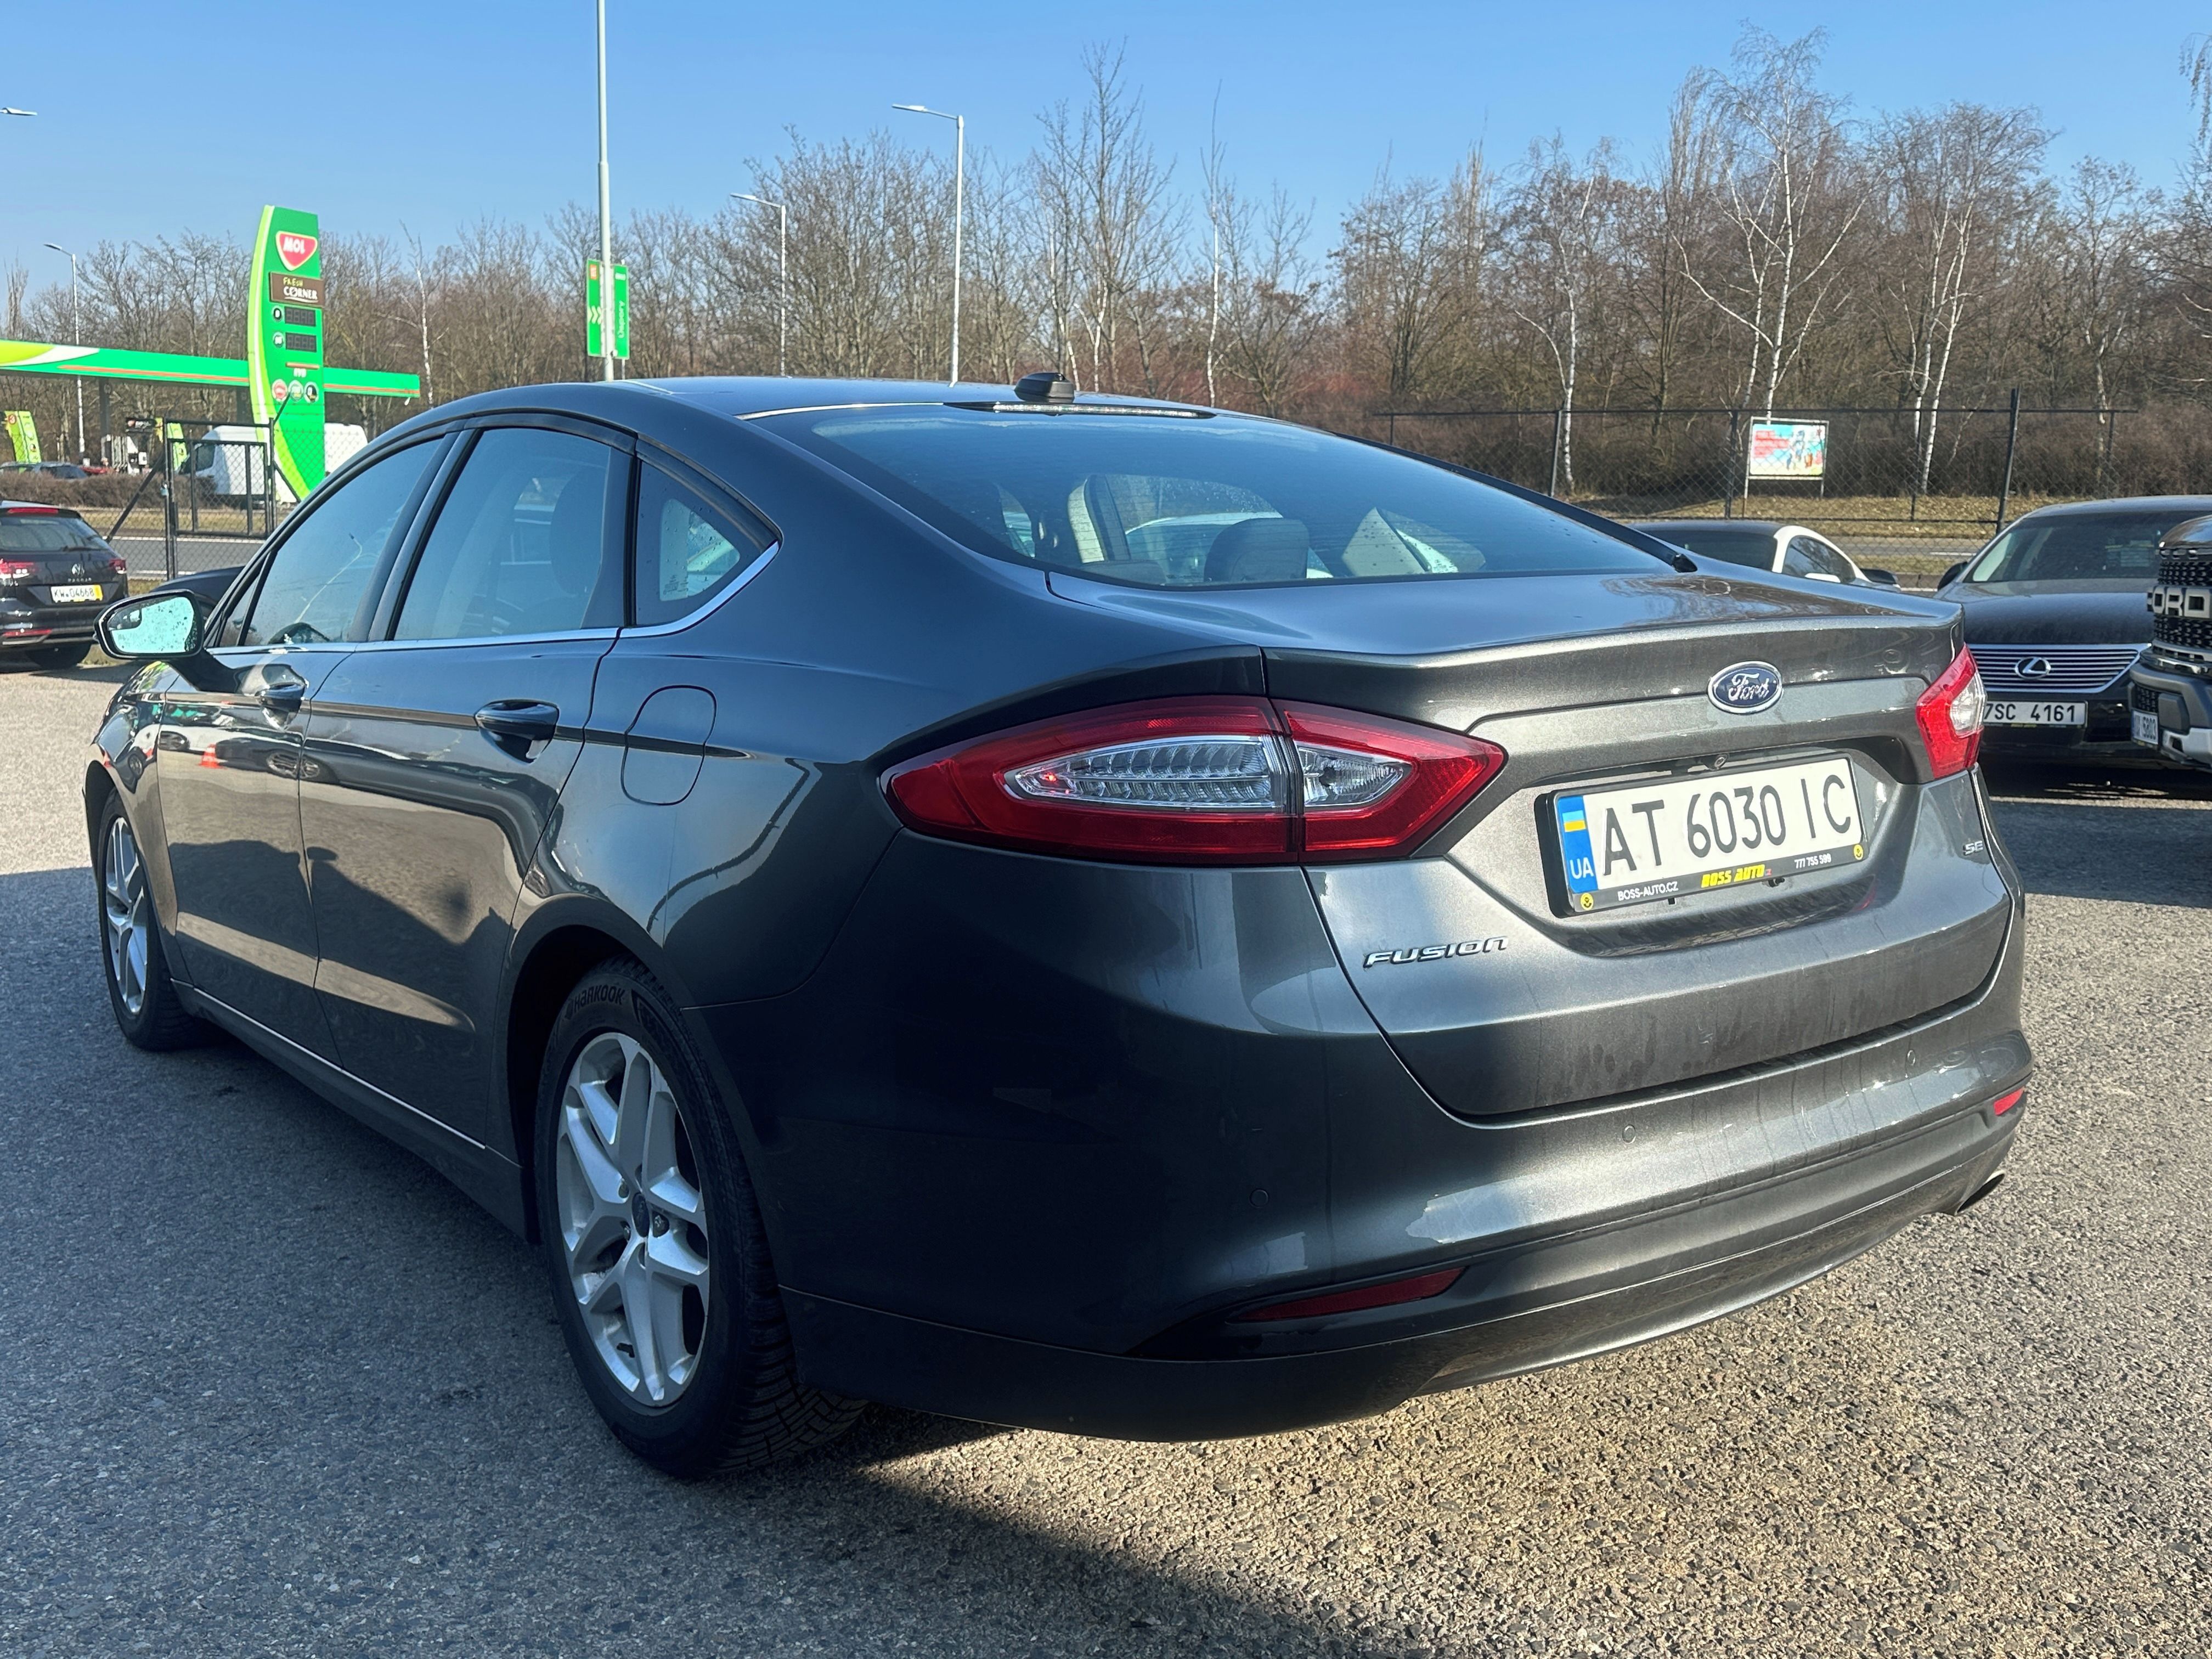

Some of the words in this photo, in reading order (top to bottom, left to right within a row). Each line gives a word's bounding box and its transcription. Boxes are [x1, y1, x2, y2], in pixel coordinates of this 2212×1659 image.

[283, 236, 306, 254] MOL
[284, 286, 318, 300] CORNER
[1728, 673, 1769, 701] Ford
[1984, 703, 2016, 720] 7SC
[2030, 704, 2075, 723] 4161
[1603, 799, 1665, 876] AT
[1686, 785, 1786, 858] 6030
[1800, 774, 1851, 839] IC
[1963, 840, 1983, 855] SE
[1570, 857, 1594, 879] UA
[1795, 858, 1805, 868] 777
[1807, 855, 1818, 866] 755
[1819, 853, 1832, 865] 599
[1701, 870, 1732, 888] BOSS
[1734, 864, 1765, 882] AUTO
[1617, 881, 1679, 901] BOSS-AUTO.CZ
[1363, 935, 1509, 968] FUSION
